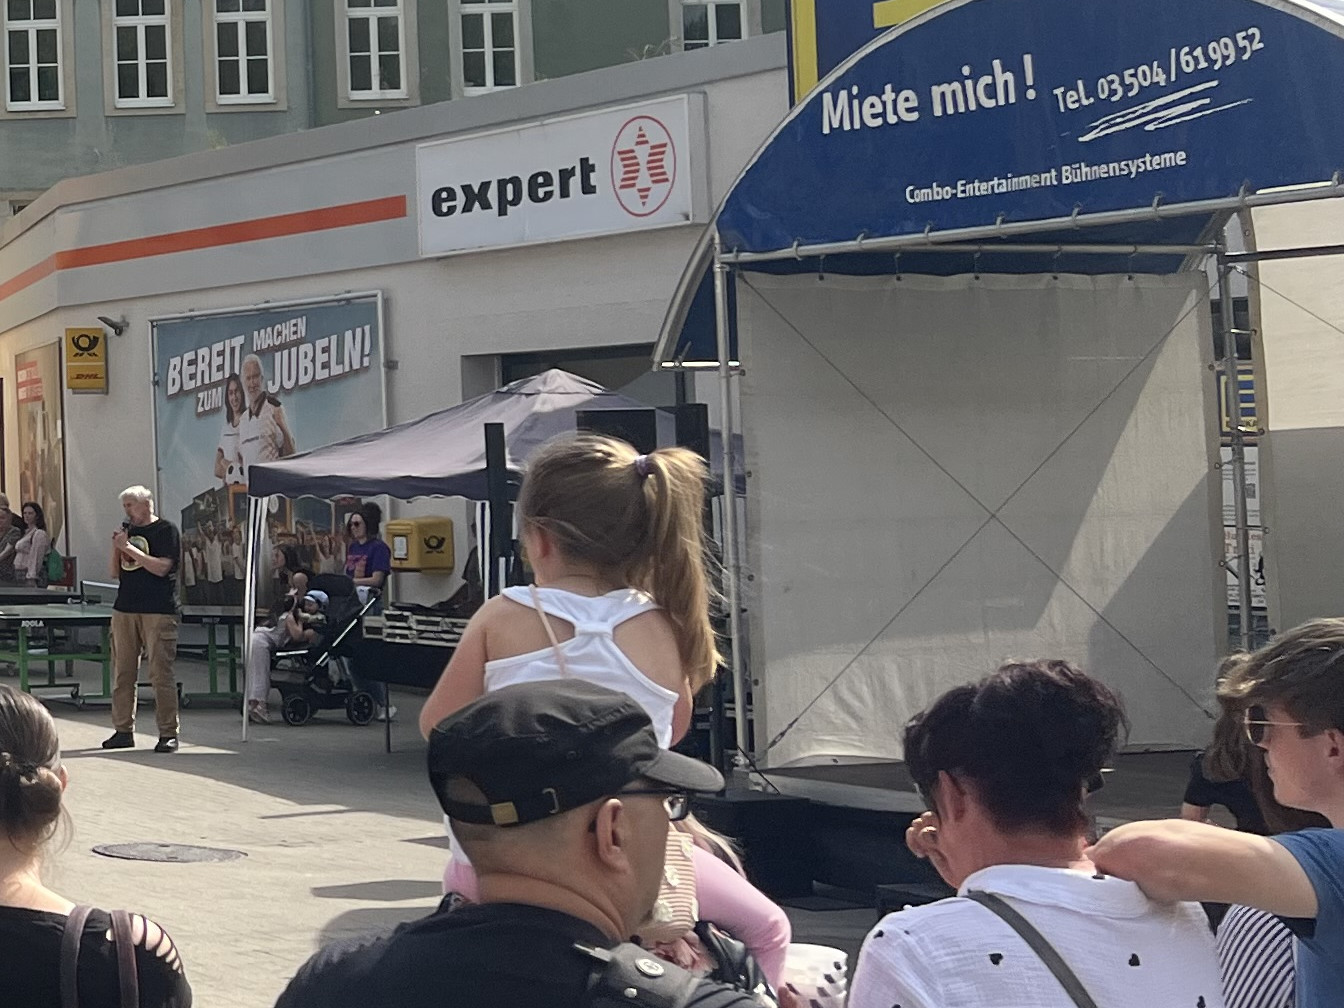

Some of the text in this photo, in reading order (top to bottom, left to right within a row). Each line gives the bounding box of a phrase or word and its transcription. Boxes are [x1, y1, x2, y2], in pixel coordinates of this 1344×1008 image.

[822, 83, 920, 134] Miete
[1053, 79, 1095, 113] Tel.
[431, 156, 597, 218] expert
[905, 150, 1187, 203] Combo-Entertainment Bühnensysteme
[167, 315, 307, 396] BEREIT MACHEN
[196, 324, 372, 413] ZUM JUBELN!
